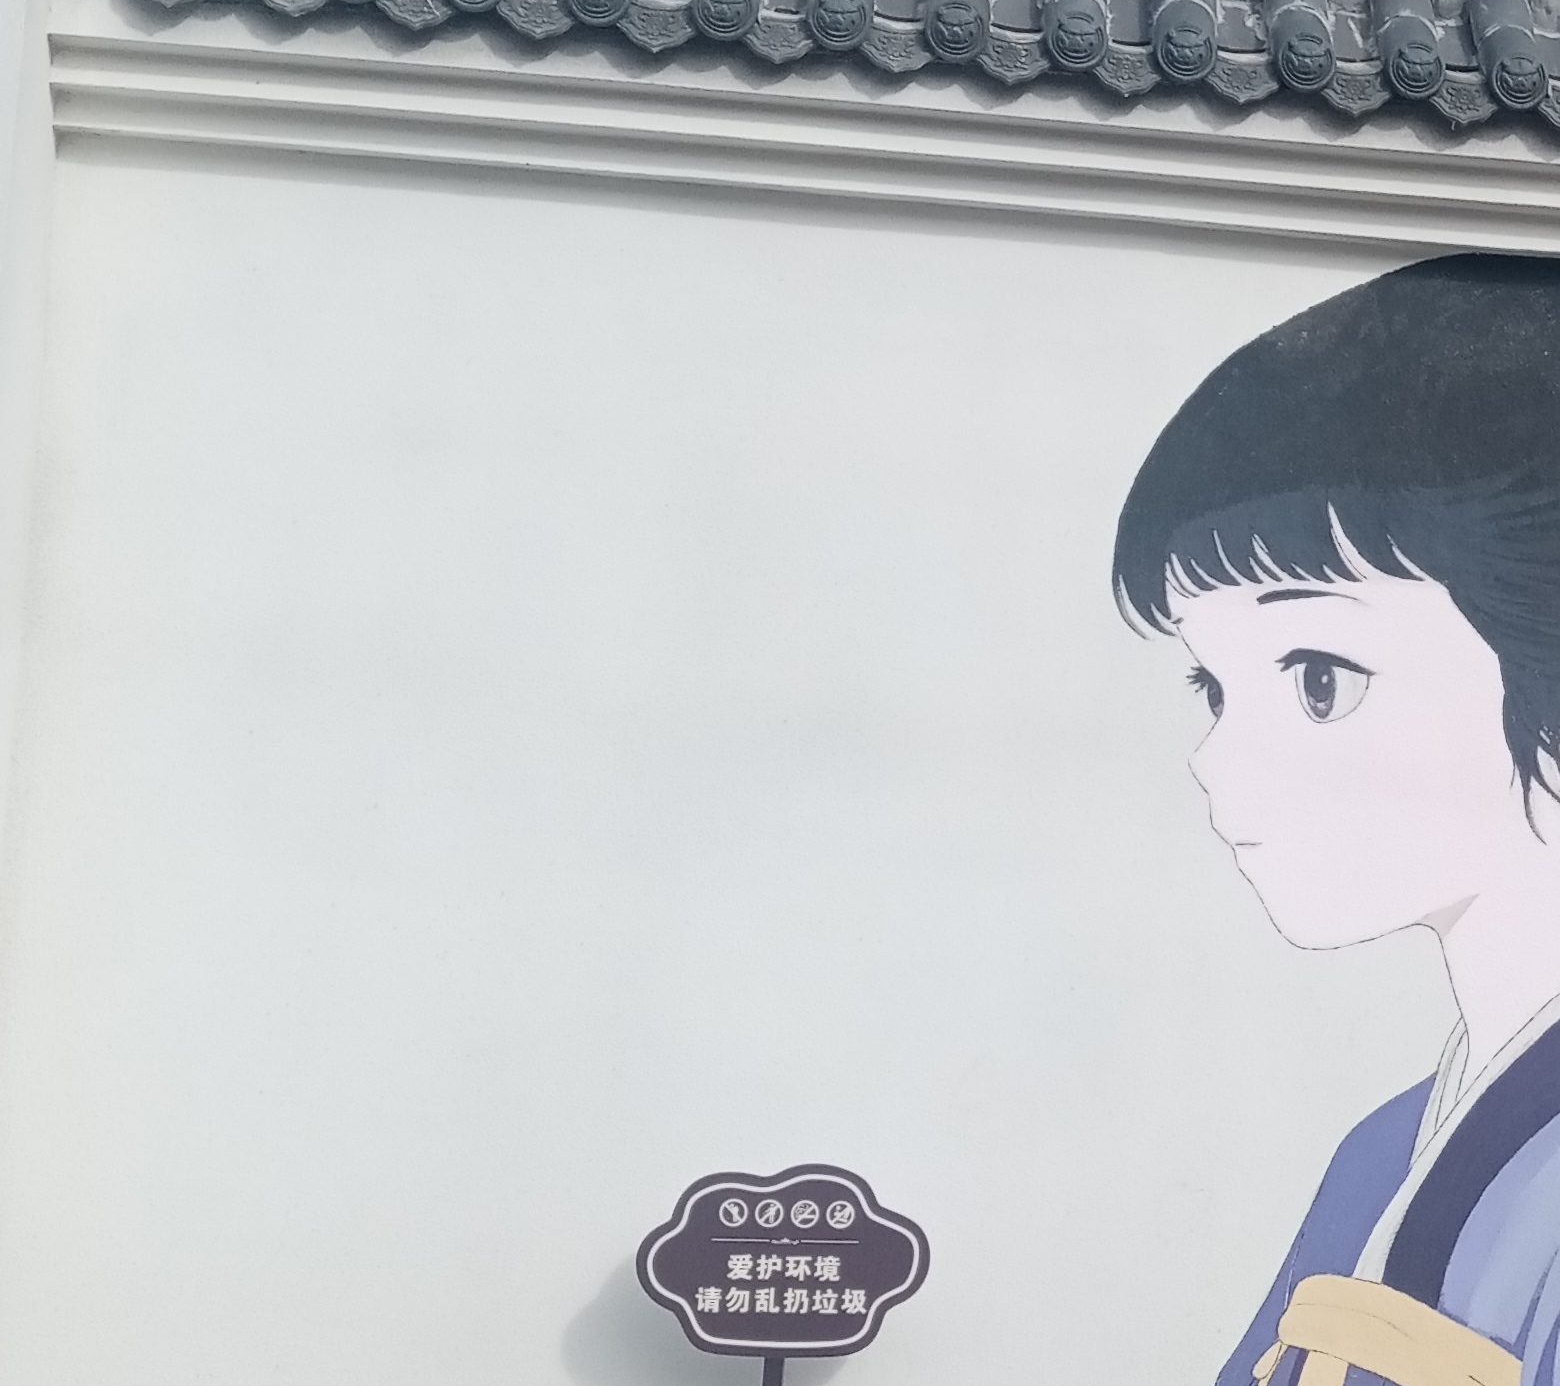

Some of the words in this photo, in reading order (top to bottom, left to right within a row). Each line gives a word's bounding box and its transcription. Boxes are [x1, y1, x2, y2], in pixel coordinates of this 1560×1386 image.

[726, 1253, 841, 1282] 爱护环境
[694, 1286, 867, 1315] 请勿乱扔垃圾
